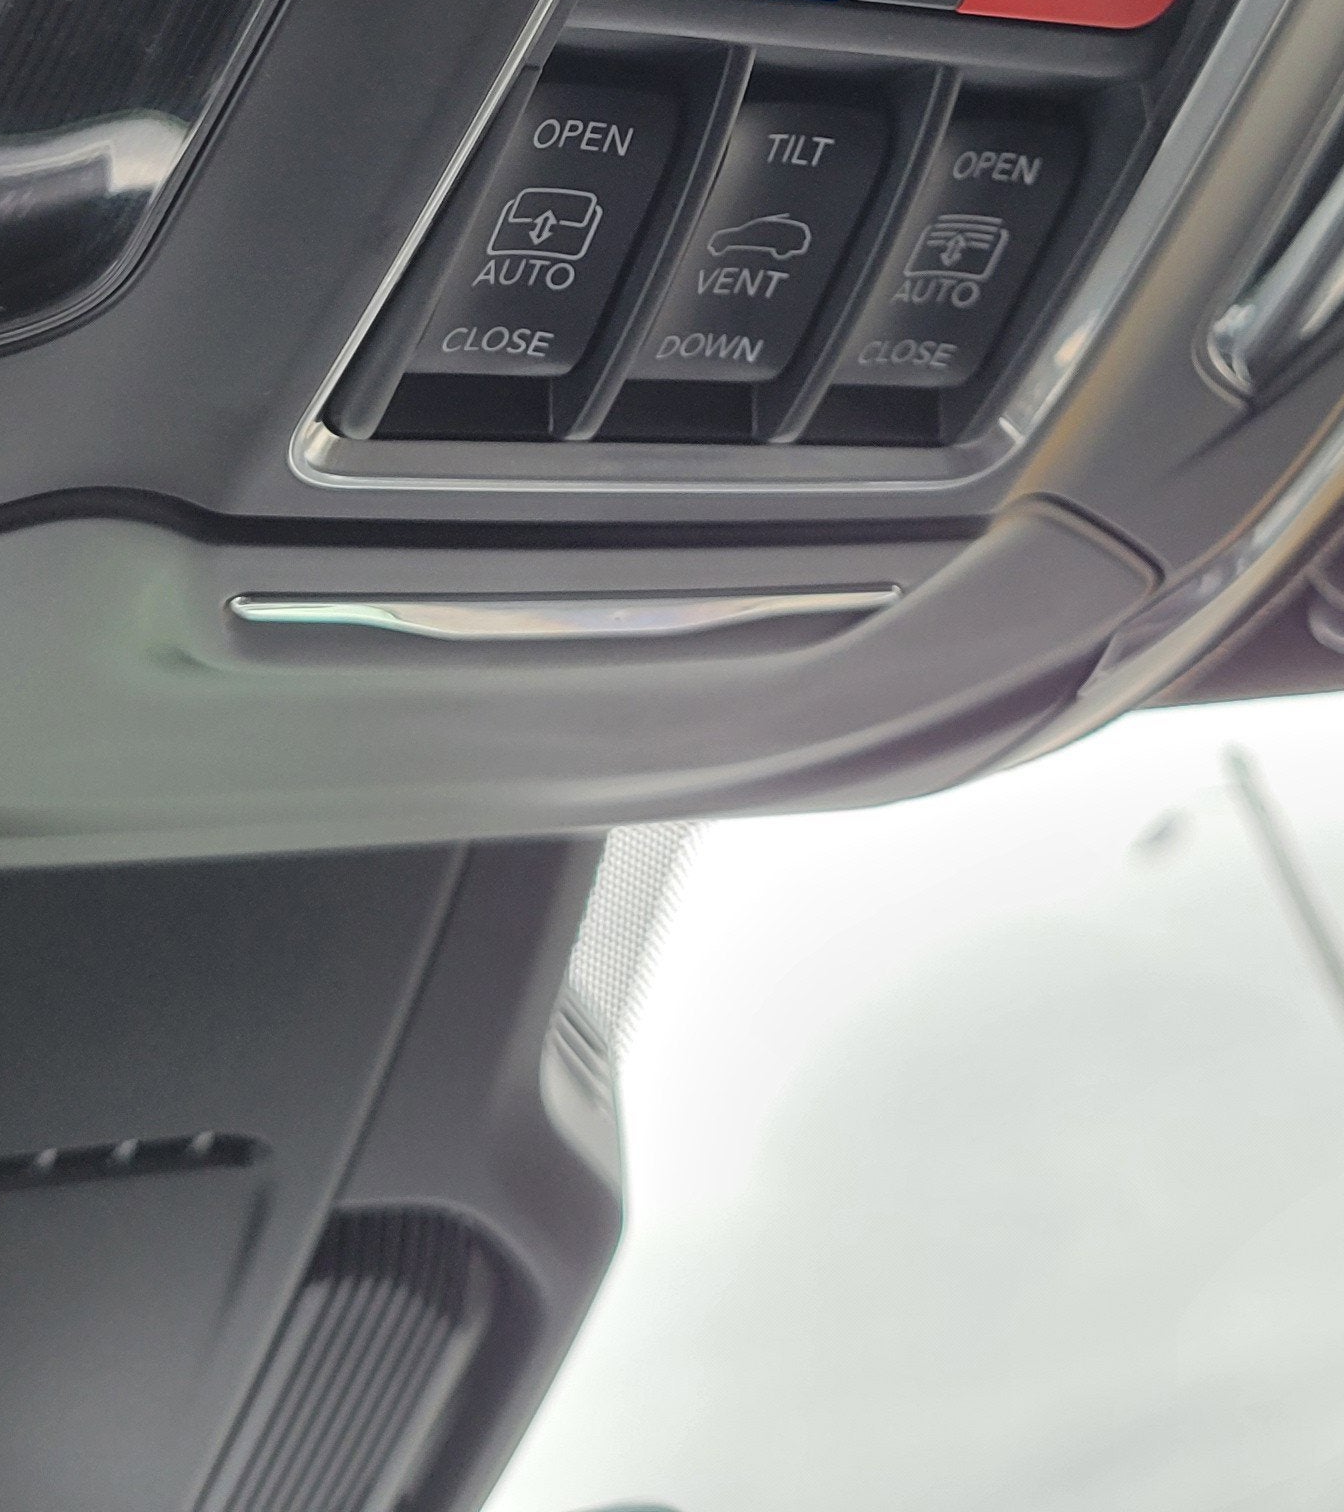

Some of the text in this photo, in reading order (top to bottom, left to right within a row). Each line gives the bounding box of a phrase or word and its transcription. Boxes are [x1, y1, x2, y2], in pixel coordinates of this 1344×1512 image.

[532, 118, 634, 157] OPEN
[766, 133, 835, 168] TILT
[953, 150, 1043, 186] OPEN
[472, 259, 576, 292] AUTO
[695, 267, 789, 300] VENT
[893, 280, 981, 310] AUTO
[441, 325, 555, 358] CLOSE
[656, 331, 765, 363] DOWN
[857, 339, 957, 369] CLOSE
